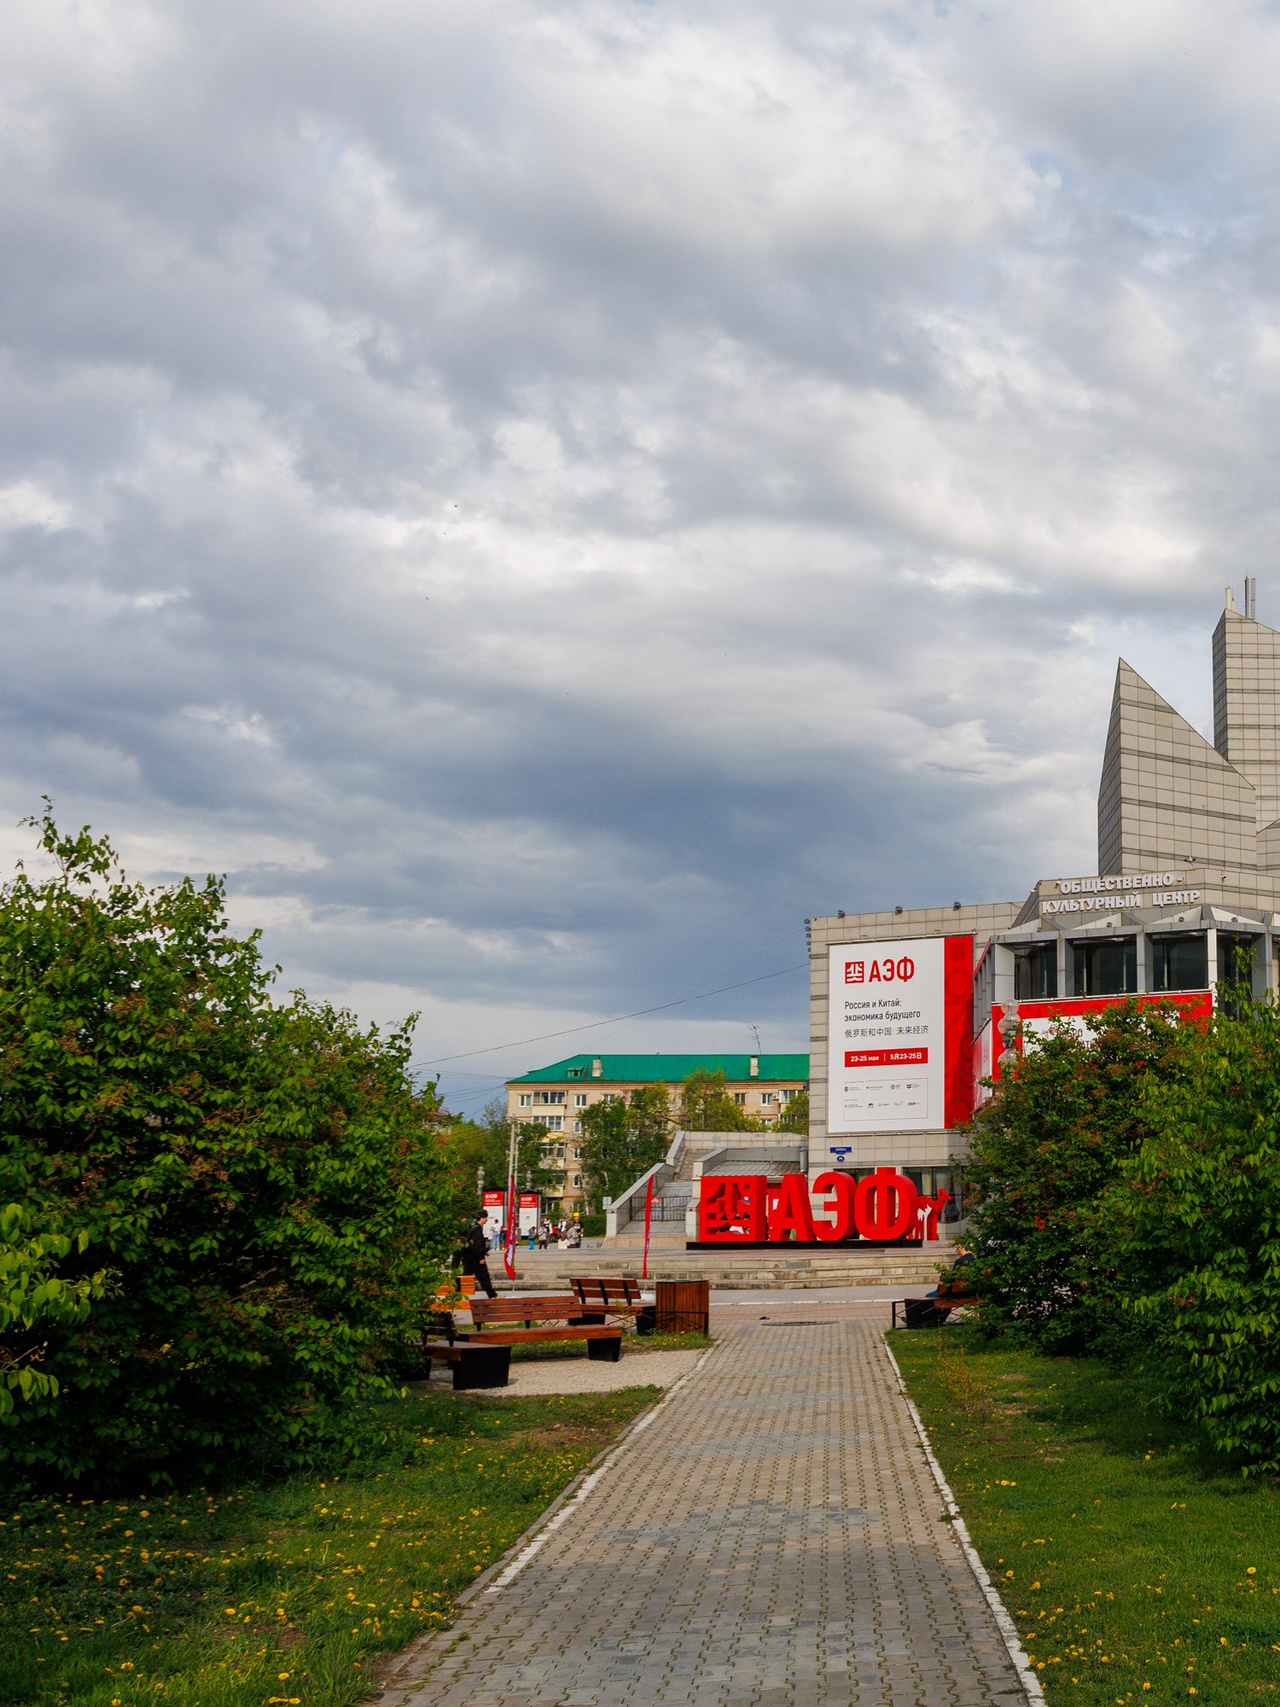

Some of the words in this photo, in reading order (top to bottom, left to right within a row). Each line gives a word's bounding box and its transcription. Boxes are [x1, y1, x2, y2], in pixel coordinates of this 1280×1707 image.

[1042, 892, 1141, 914] КУЛЬТУРНЫЙ
[1152, 890, 1200, 908] ЦЕНТР
[868, 956, 915, 983] АЭФ
[844, 1000, 871, 1010] Россия
[878, 997, 902, 1008] Китай:
[844, 1012, 884, 1022] экономика
[885, 1010, 921, 1021] будущего
[890, 1052, 922, 1060] 5月23-25日
[769, 1167, 918, 1241] АЭФ
